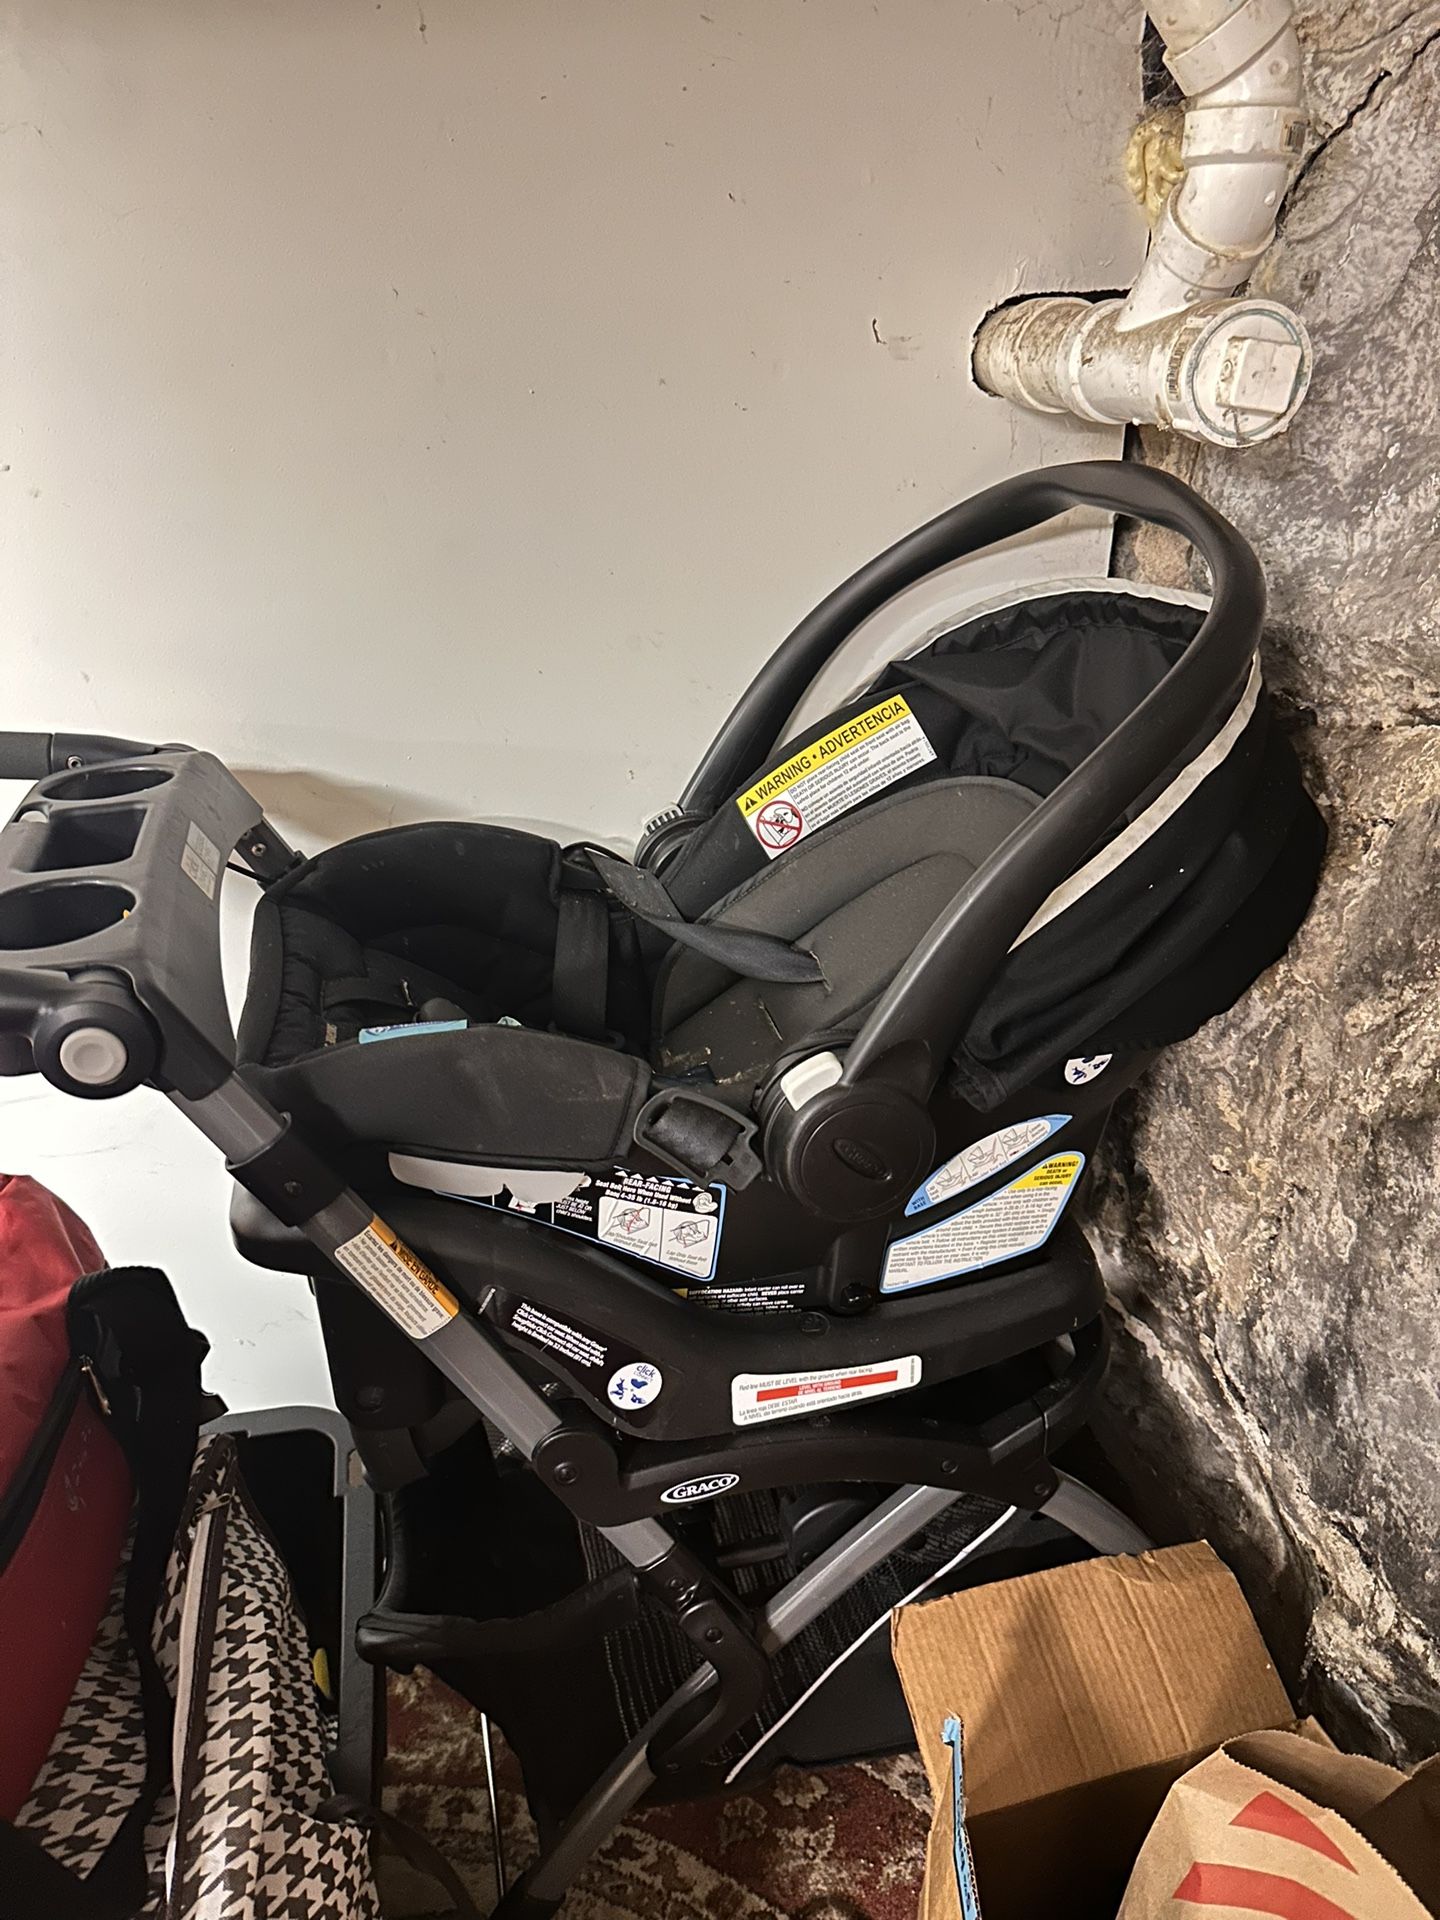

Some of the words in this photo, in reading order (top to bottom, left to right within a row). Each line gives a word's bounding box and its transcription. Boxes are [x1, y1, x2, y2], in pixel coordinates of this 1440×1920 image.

[755, 756, 811, 800] WARNING
[818, 701, 906, 759] ADVERTENCIA
[792, 787, 808, 799] DEATH
[814, 770, 833, 785] SERIOUS
[833, 760, 849, 773] INJURY
[796, 780, 806, 789] NOT
[595, 1178, 609, 1188] Seat
[609, 1182, 622, 1191] Belt
[621, 1184, 636, 1193] Here
[636, 1187, 653, 1197] When
[653, 1191, 668, 1200] Used
[668, 1194, 691, 1204] Without
[622, 1176, 671, 1194] REAR-FACING
[568, 1206, 586, 1214] BELOW
[396, 1248, 413, 1265] MISE
[409, 1262, 421, 1274] EN
[417, 1271, 439, 1294] GARDE
[636, 1364, 656, 1377] click
[782, 1376, 797, 1384] LEVEL
[672, 1476, 729, 1500] GRACO
